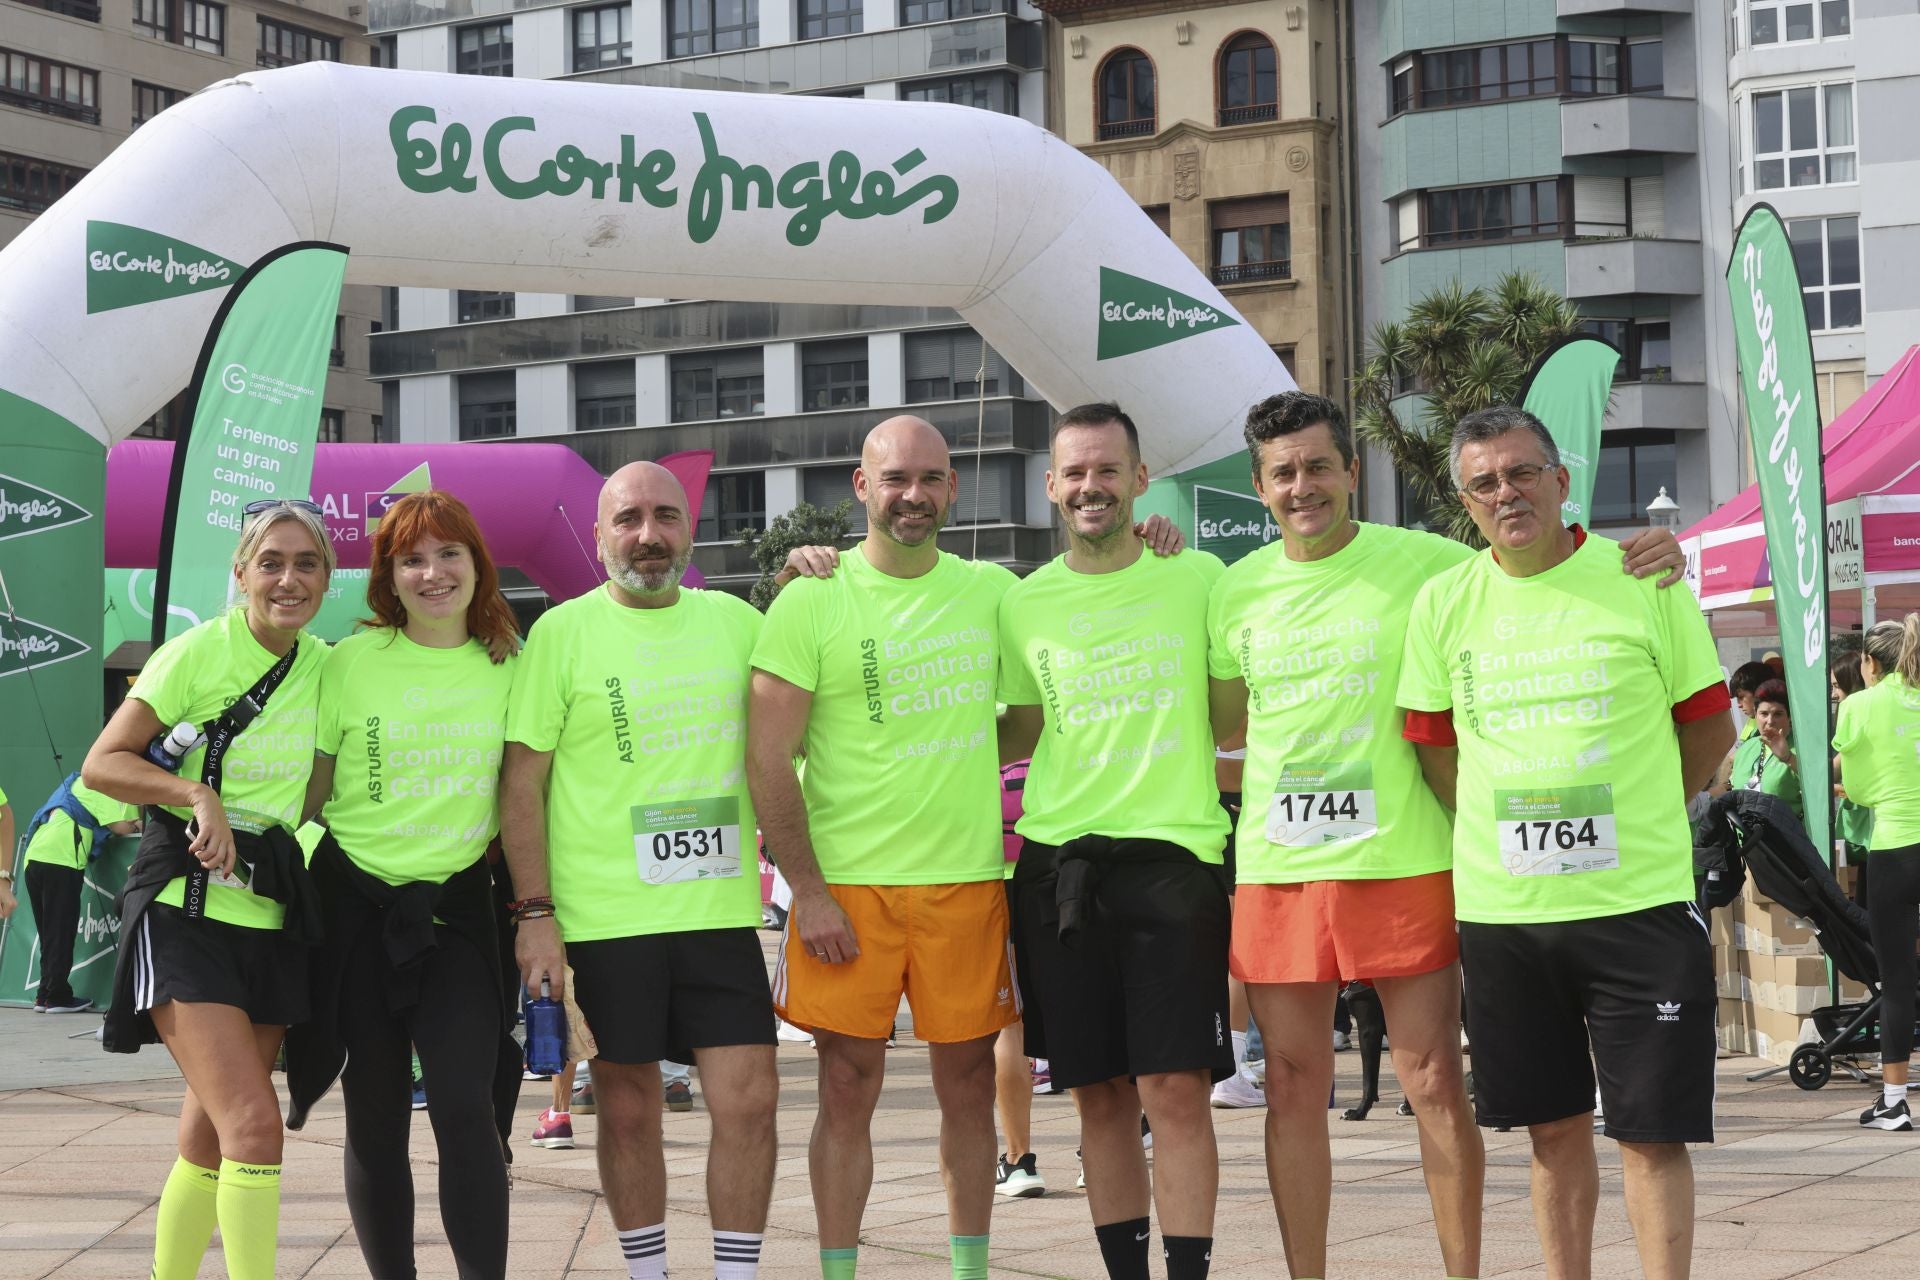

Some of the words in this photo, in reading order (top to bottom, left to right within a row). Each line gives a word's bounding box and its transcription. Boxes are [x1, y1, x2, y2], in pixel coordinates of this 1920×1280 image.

[389, 104, 477, 194] El
[482, 115, 678, 209] Corte
[687, 111, 960, 247] Inglés
[90, 250, 112, 271] El
[113, 251, 162, 274] Corte
[165, 248, 230, 285] Inglés
[1103, 301, 1121, 321] El
[1123, 302, 1165, 321] Corte
[1167, 296, 1219, 329] Inglés
[223, 417, 299, 454] Tenemos
[217, 444, 240, 461] un
[242, 452, 280, 472] gran
[213, 466, 275, 494] camino
[209, 488, 239, 507] por
[206, 509, 241, 532] dela
[1200, 519, 1218, 538] El
[1219, 518, 1261, 538] Corte
[1827, 517, 1858, 554] ORAL
[1893, 536, 1920, 546] banc
[1254, 629, 1280, 649] En
[1287, 616, 1380, 642] marcha
[883, 640, 913, 659] En
[1055, 648, 1086, 669] En
[1092, 632, 1185, 660] marcha
[1254, 645, 1346, 677] contra
[1349, 638, 1378, 663] el
[1479, 652, 1507, 673] En
[1515, 639, 1611, 668] marcha
[861, 637, 884, 724] ASTURIAS
[887, 654, 974, 685] contra
[1059, 661, 1153, 695] contra
[1158, 651, 1184, 677] el
[1479, 671, 1576, 702] contra
[1580, 661, 1612, 691] el
[628, 677, 659, 696] En
[1263, 670, 1380, 707] cáncer
[605, 676, 634, 764] ASTURIAS
[635, 694, 721, 724] contra
[1068, 687, 1185, 726] cáncer
[1485, 695, 1615, 734] cáncer
[230, 731, 304, 751] contra
[387, 720, 417, 740] En
[426, 720, 499, 737] march
[209, 728, 228, 770] SWOOSH
[367, 715, 383, 804] ASTURIAS
[388, 744, 481, 768] contra
[226, 753, 309, 782] cánc
[1494, 755, 1571, 777] LABORAL
[644, 809, 662, 818] Gijón
[646, 816, 668, 824] contra
[677, 812, 697, 820] cáncer
[1280, 792, 1359, 822] 1744
[653, 827, 722, 861] 0531
[1515, 817, 1599, 851] 1764
[189, 872, 201, 918] SWOOSH
[237, 1166, 281, 1176] AWEN
